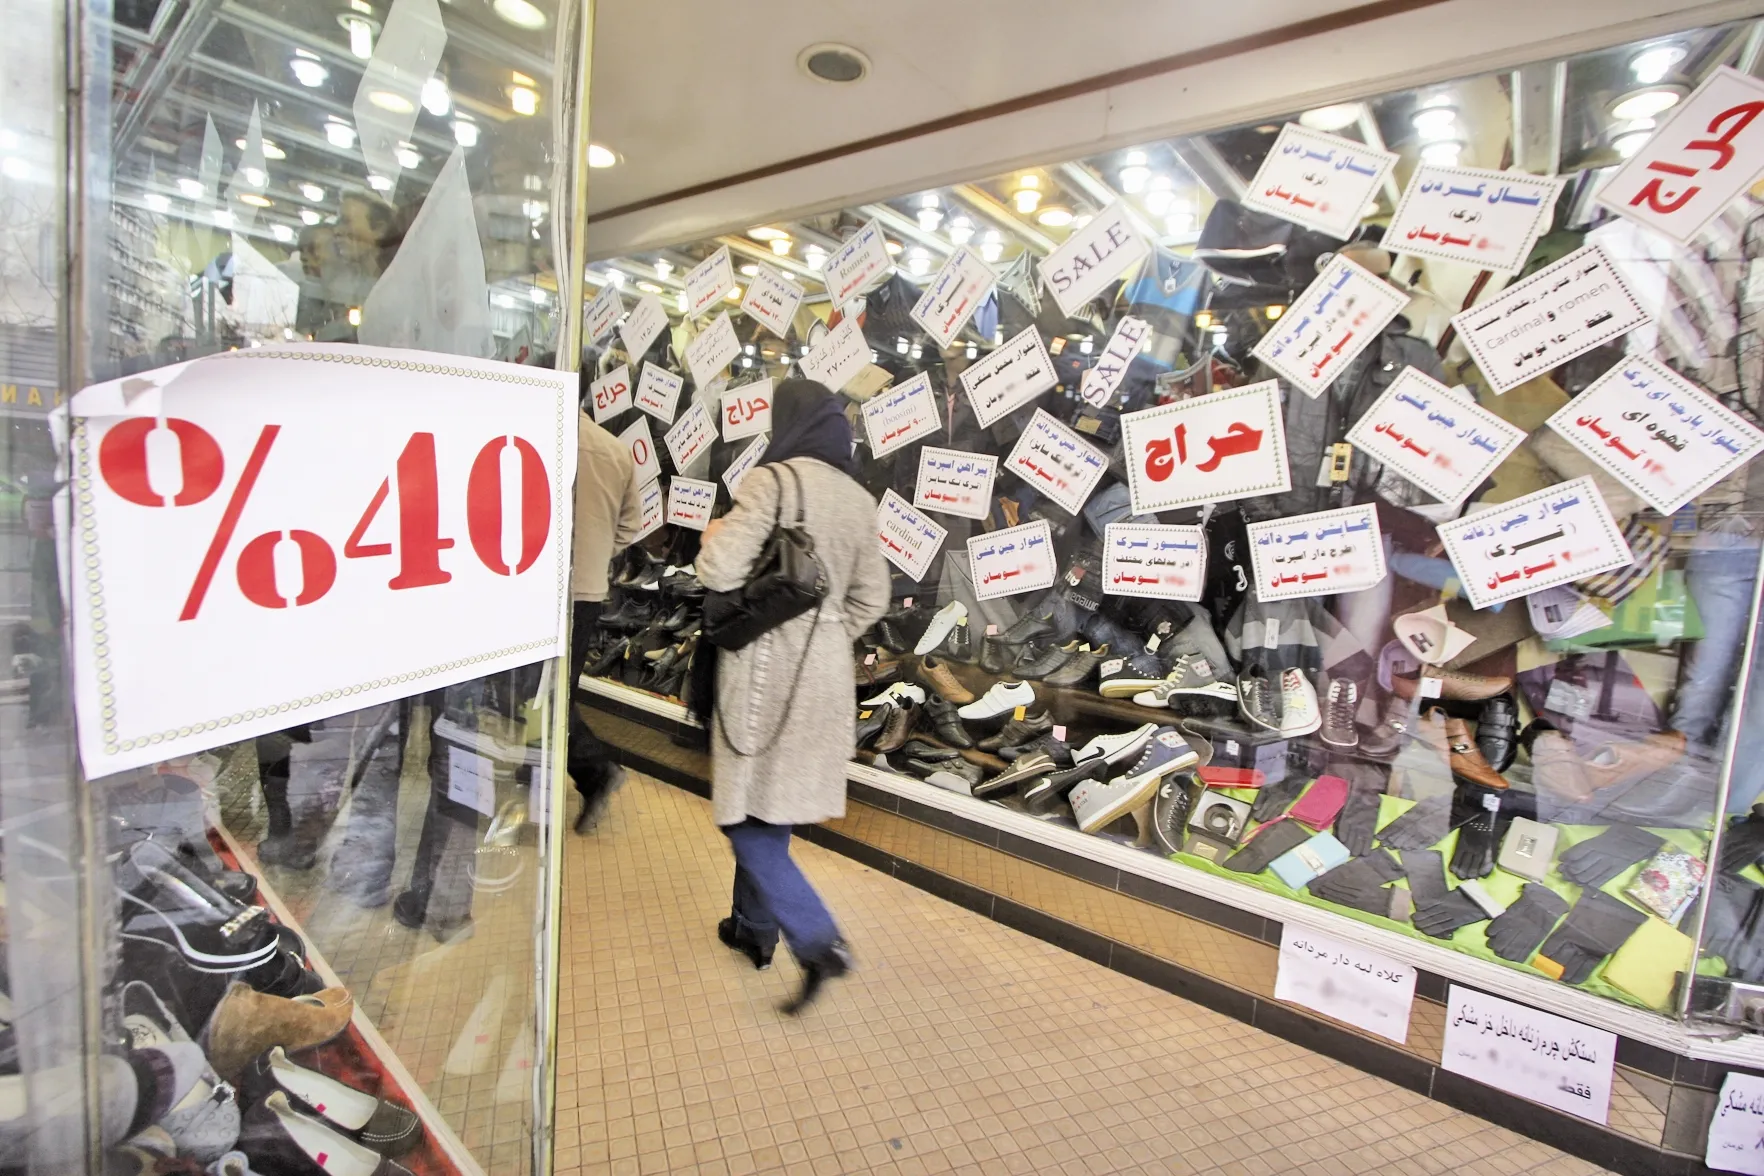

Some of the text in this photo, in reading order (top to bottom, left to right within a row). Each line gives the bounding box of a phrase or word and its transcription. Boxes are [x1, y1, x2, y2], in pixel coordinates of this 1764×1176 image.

[1627, 100, 1764, 215] حراج
[1265, 184, 1318, 208] تومان
[1487, 184, 1542, 206] شال
[1406, 224, 1476, 247] تومان
[1051, 220, 1131, 295] SALE
[1484, 313, 1546, 351] Cardinal
[1557, 281, 1611, 314] romen
[1083, 319, 1146, 406] SALE
[1310, 328, 1355, 379] تومان
[1513, 340, 1548, 367] تومان
[595, 382, 627, 410] حراج
[726, 397, 770, 426] حراج
[1427, 409, 1457, 430] جین
[880, 423, 912, 444] تومان
[1374, 420, 1436, 458] تومان
[1456, 428, 1498, 454] شلوار
[1575, 413, 1648, 461] تومان
[1621, 409, 1690, 453] قهوه ای
[1701, 428, 1742, 454] شلوار
[1076, 449, 1101, 469] شلوار
[1144, 421, 1264, 483] حراج
[927, 457, 988, 478] پیراهن اسپرت
[1018, 454, 1055, 483] تومان
[924, 487, 960, 504] تومان
[99, 416, 552, 622] %40
[1462, 493, 1581, 542] شلوار جین زنانه
[886, 517, 923, 551] cardinal
[916, 522, 937, 541] شلوار
[1020, 534, 1045, 551] شلوار
[1116, 536, 1150, 549] ترک
[1257, 530, 1310, 546] مردانه
[983, 565, 1021, 585] تومان
[1113, 571, 1161, 586] تومان
[1270, 565, 1329, 588] تومان
[1486, 553, 1558, 590] تومان
[1292, 938, 1329, 960] مردانه
[1332, 953, 1350, 966] دار
[1376, 969, 1404, 984] کلاه
[1453, 1004, 1479, 1028] مشکی
[1495, 1014, 1517, 1038] داخل
[1518, 1024, 1540, 1051] زنانه
[1557, 1075, 1592, 1101] فقط
